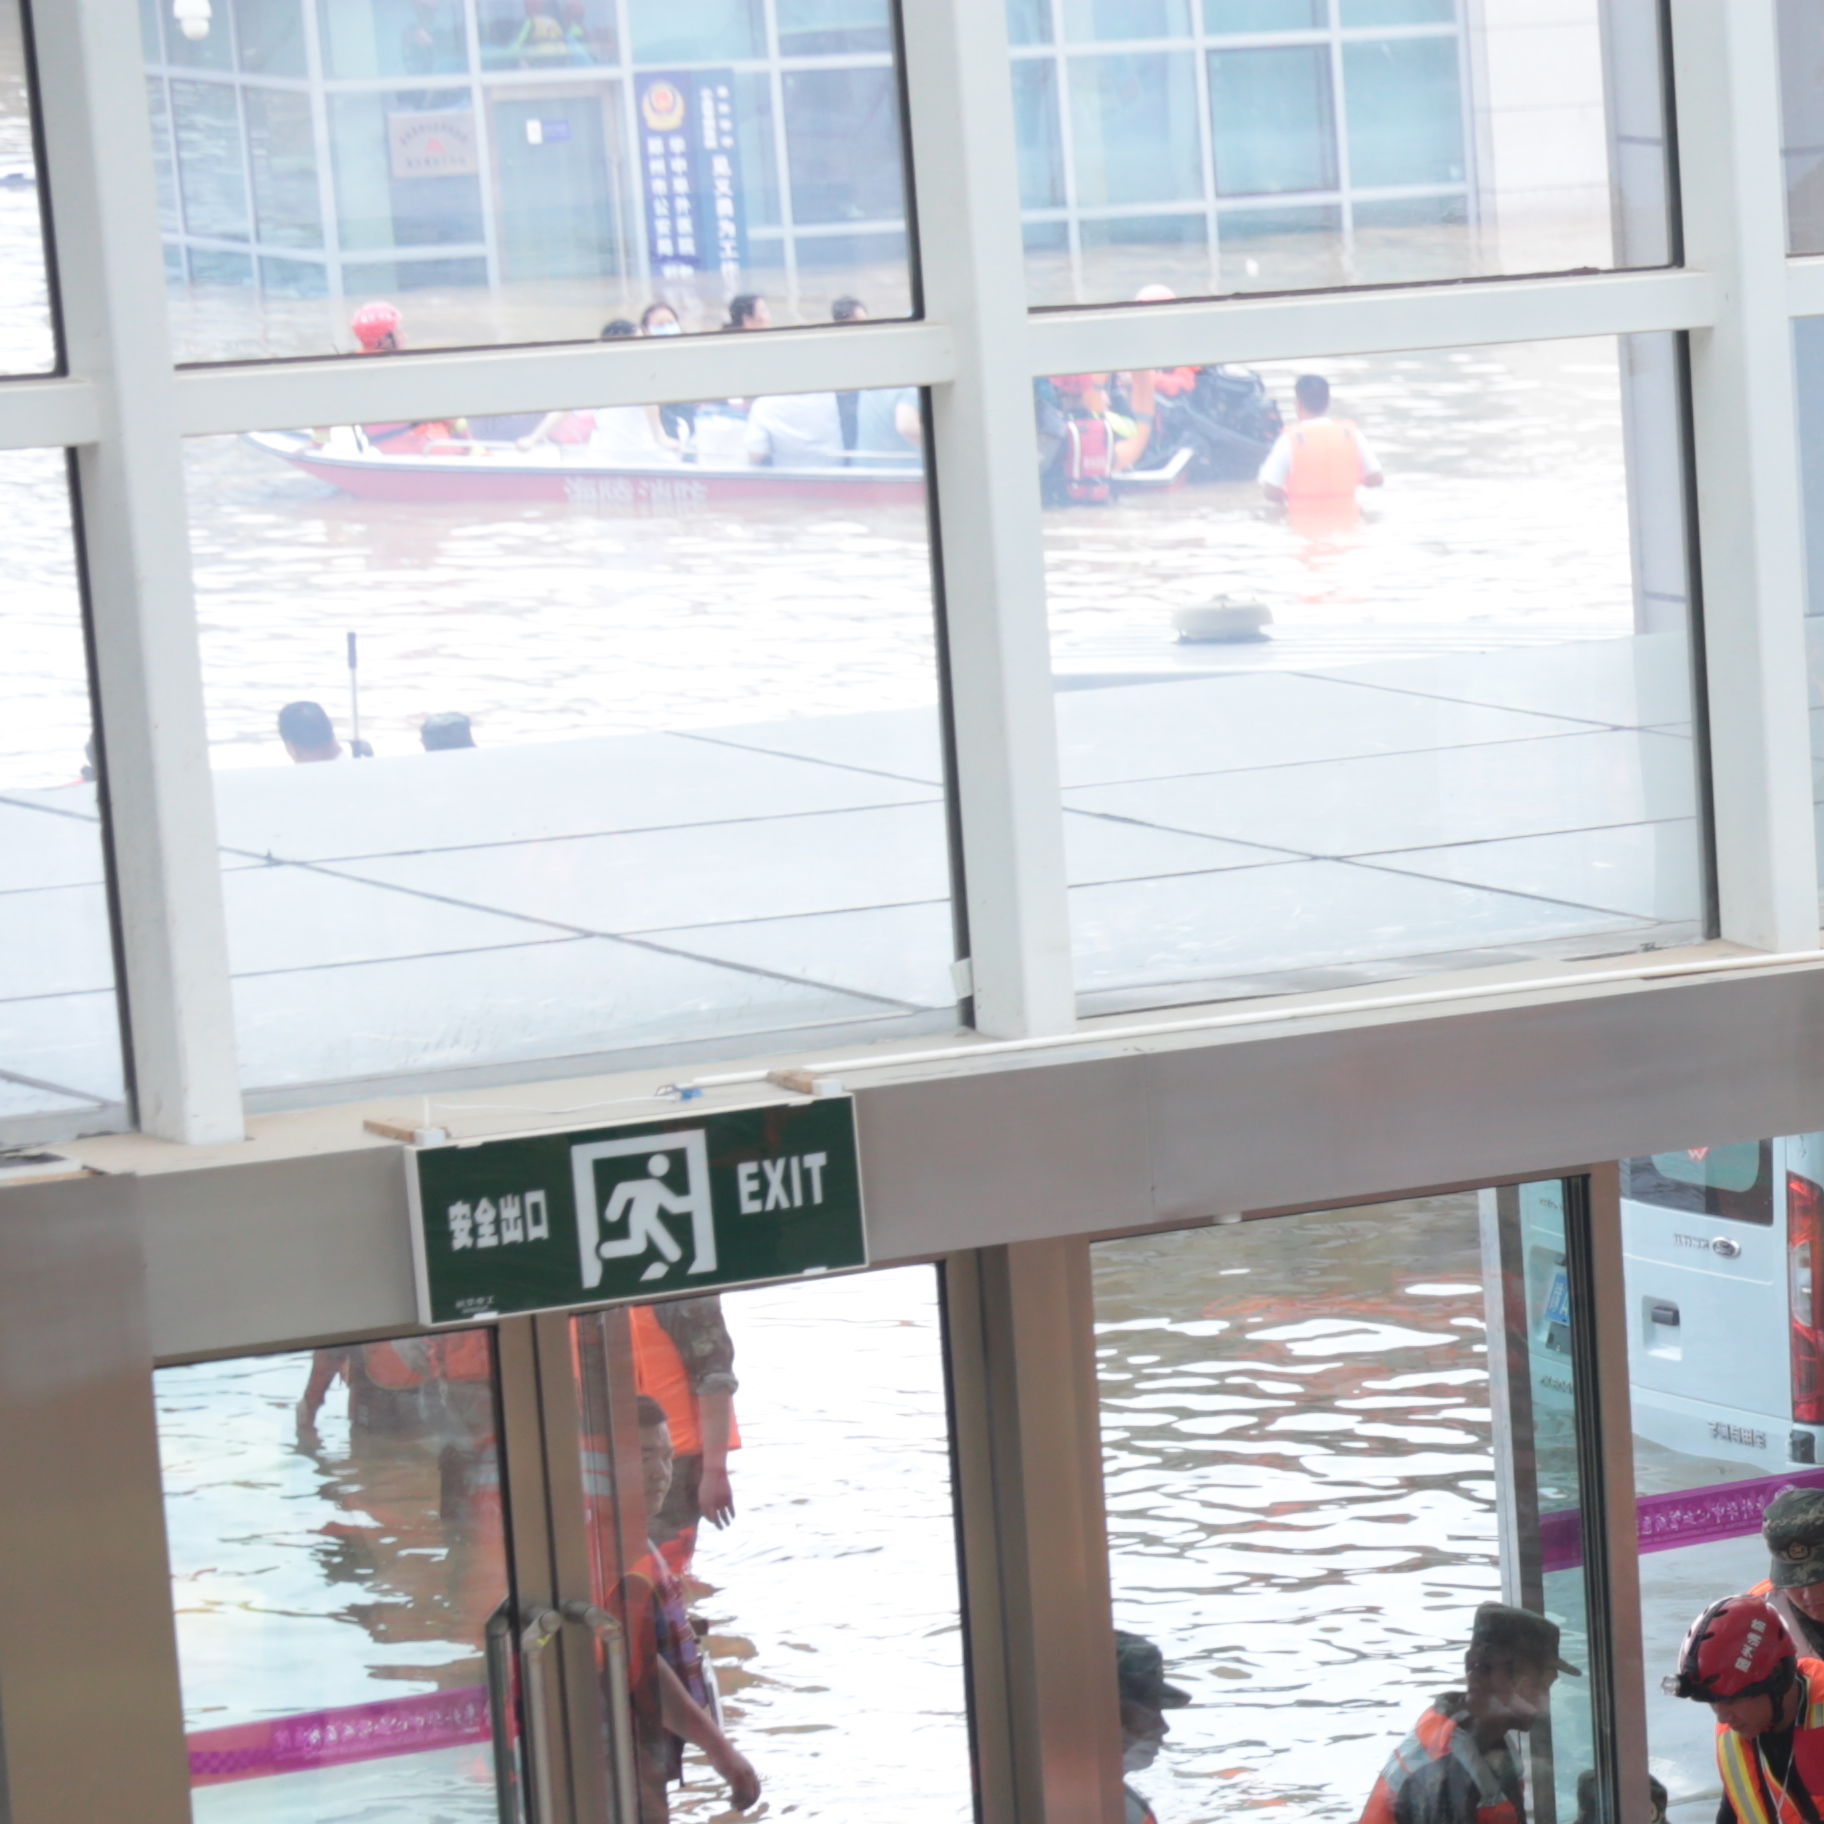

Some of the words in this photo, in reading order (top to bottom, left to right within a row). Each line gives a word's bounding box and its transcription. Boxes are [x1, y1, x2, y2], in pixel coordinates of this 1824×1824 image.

[737, 1152, 828, 1215] EXIT
[447, 1189, 550, 1251] 安全出口
